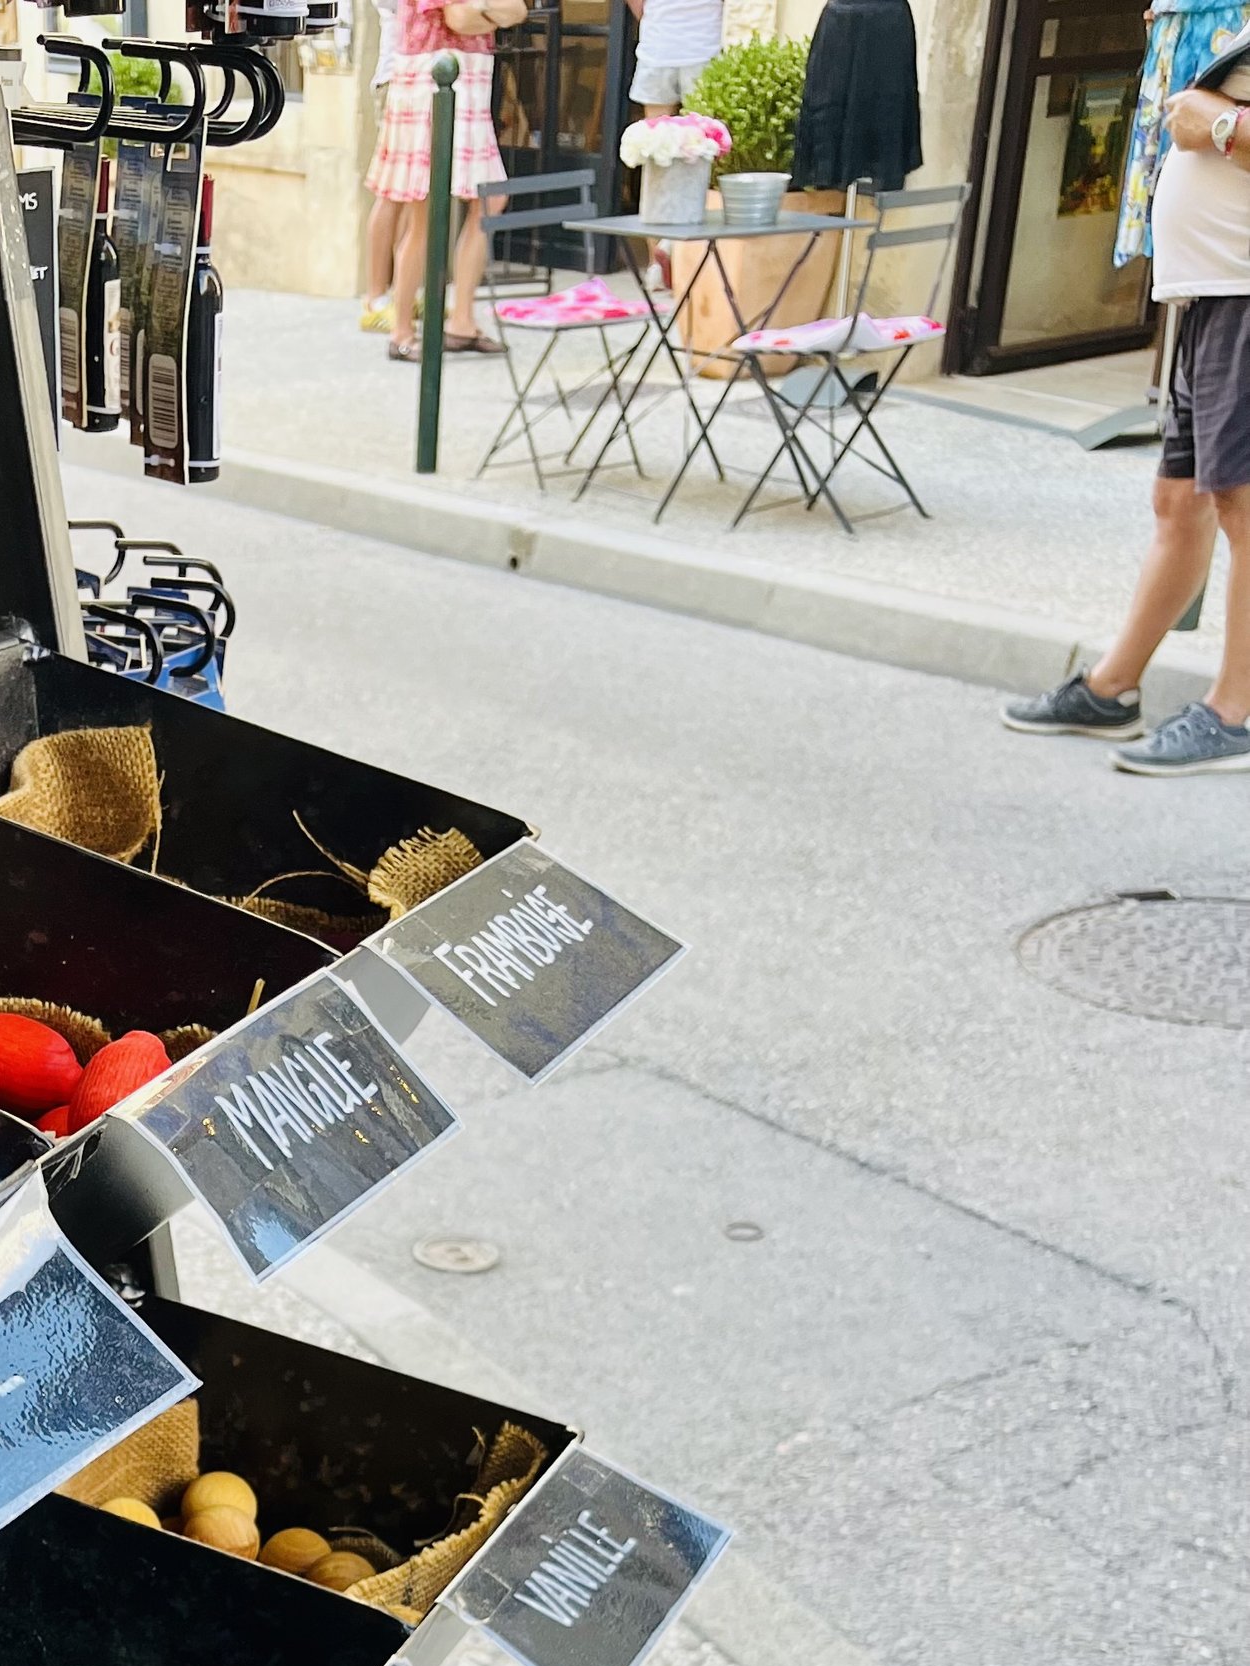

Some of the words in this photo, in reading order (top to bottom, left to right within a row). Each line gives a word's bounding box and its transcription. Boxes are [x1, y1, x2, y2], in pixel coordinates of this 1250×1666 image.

[433, 884, 595, 1008] FRAMBOISE
[214, 1031, 379, 1171] MANGUE
[513, 1508, 638, 1628] VANILLE
